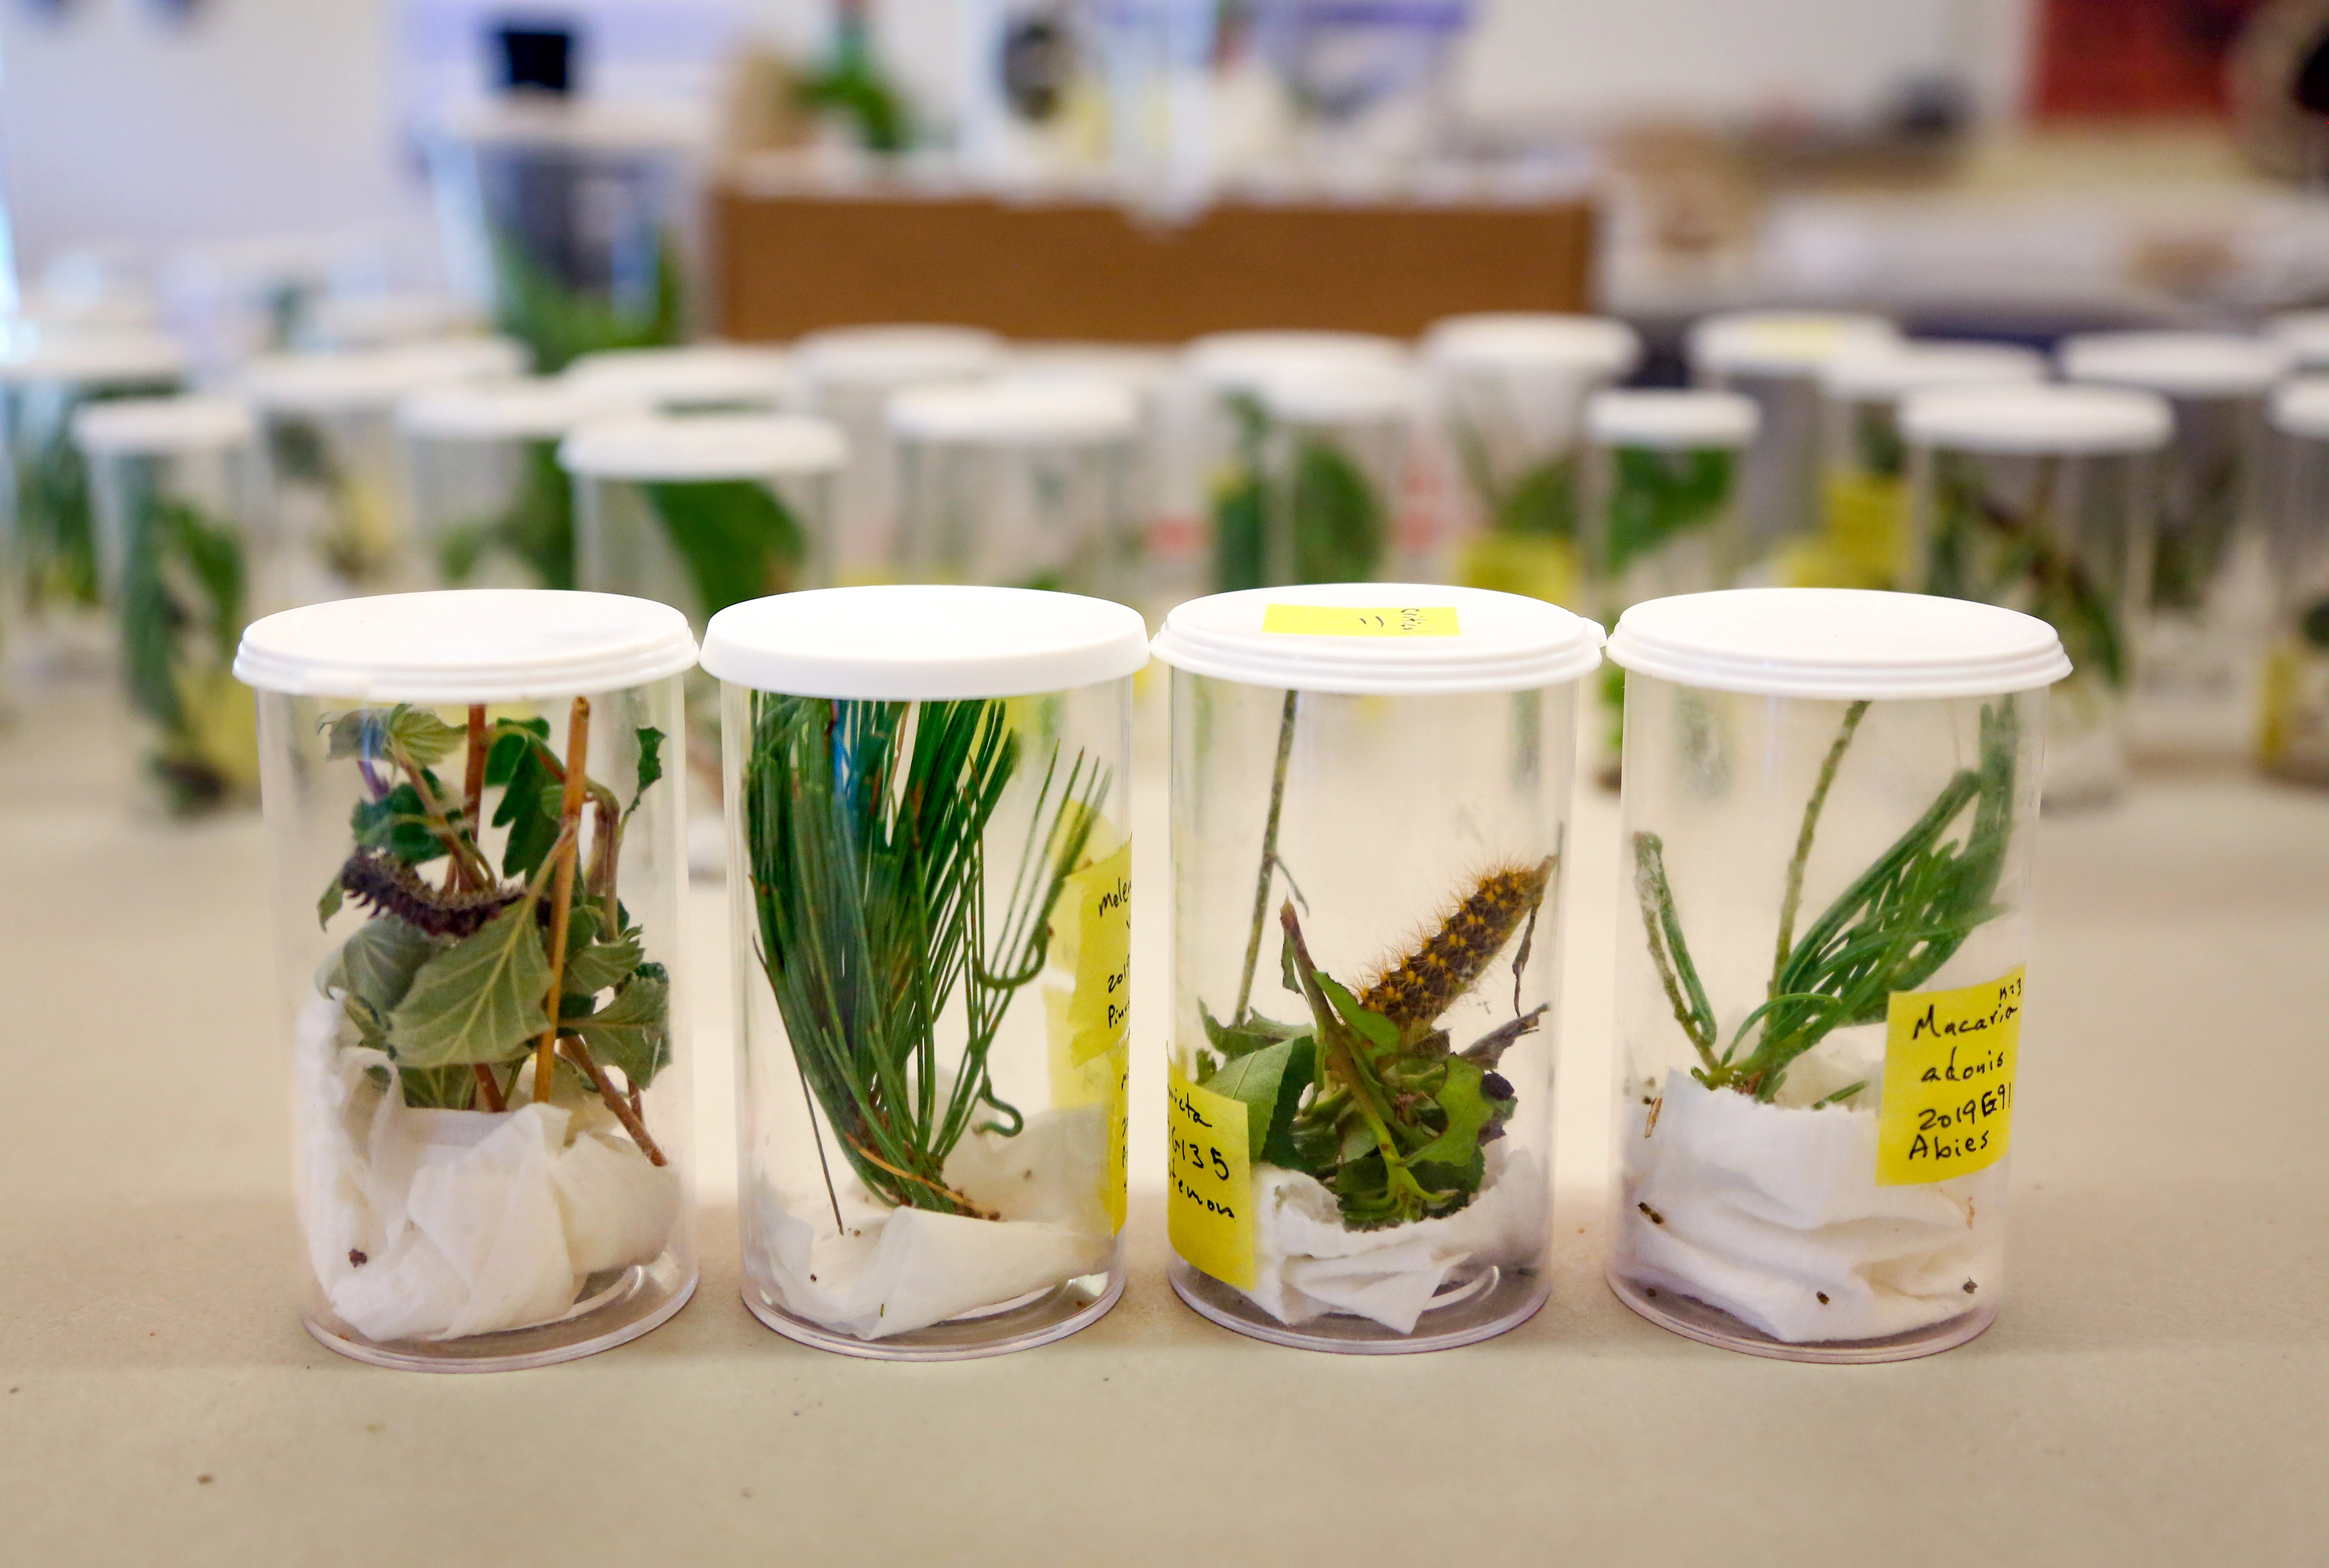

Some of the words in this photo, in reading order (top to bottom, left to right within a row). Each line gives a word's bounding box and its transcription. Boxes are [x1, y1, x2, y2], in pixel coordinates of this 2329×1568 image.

[1912, 1004, 2018, 1040] Macaria
[1921, 1046, 2004, 1082] adonis
[1909, 1130, 1989, 1161] Abies
